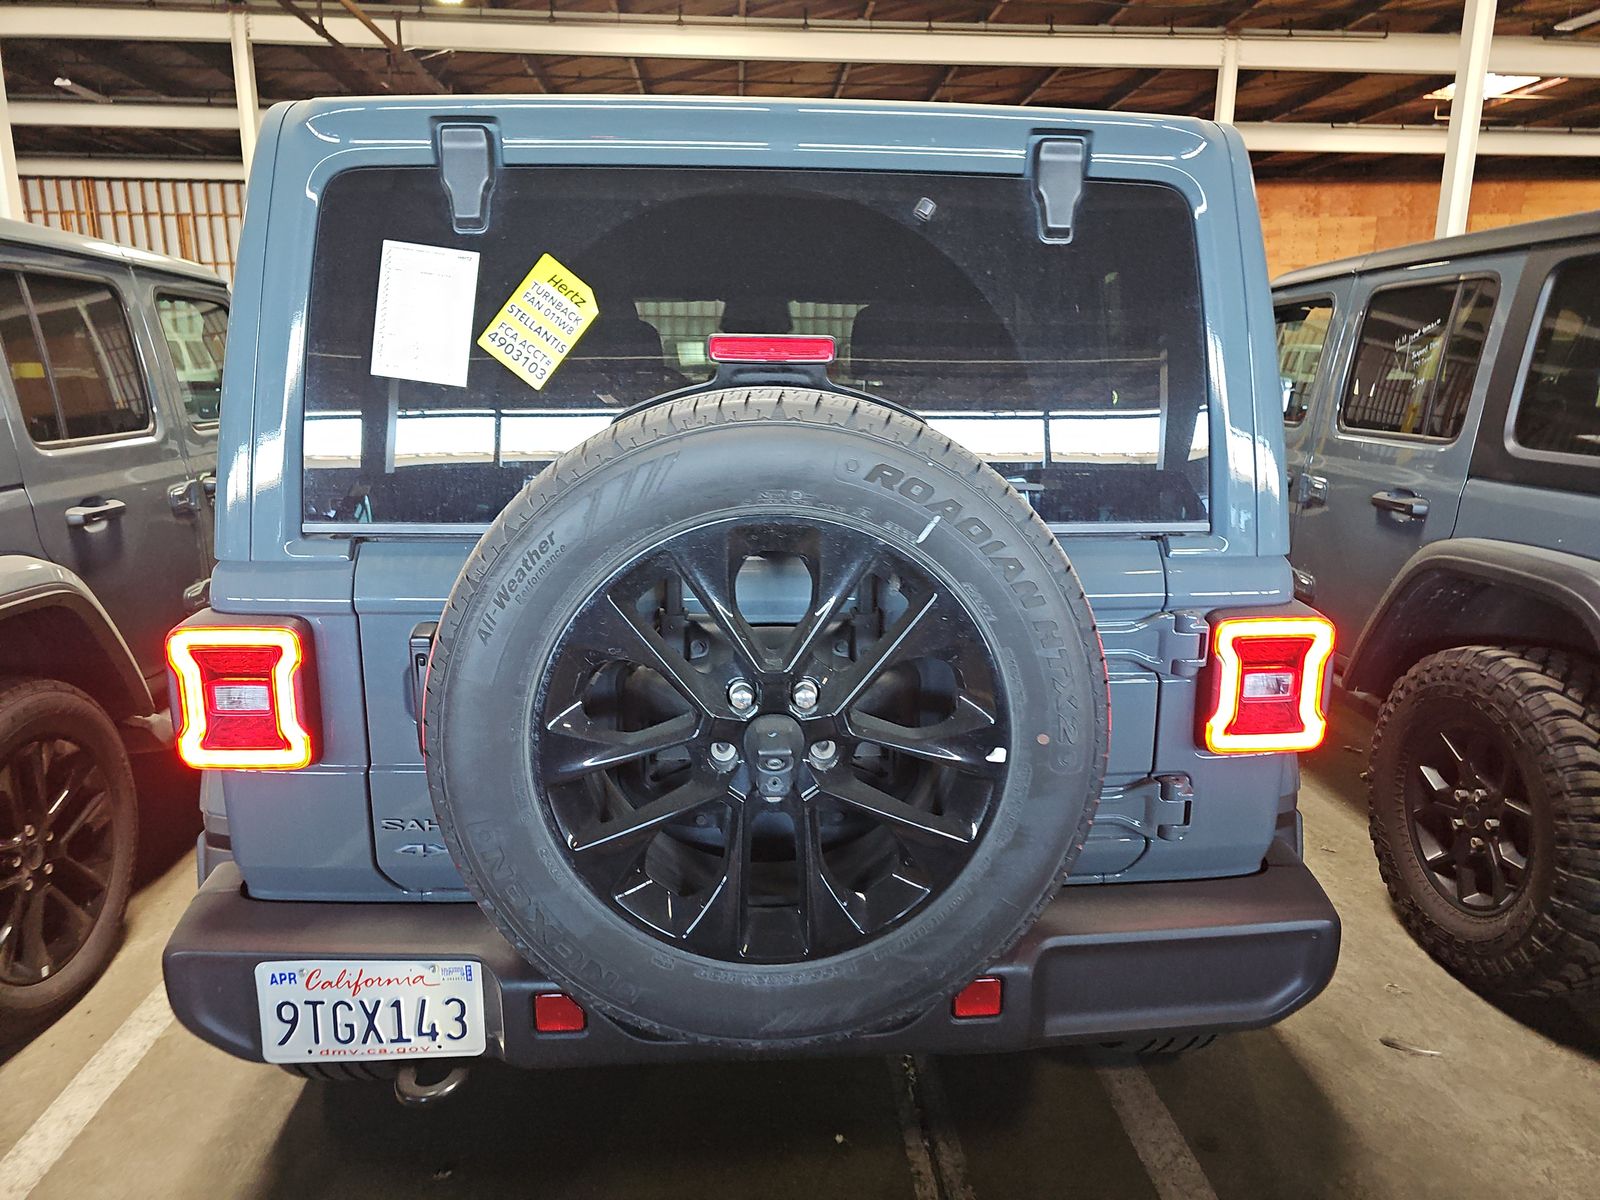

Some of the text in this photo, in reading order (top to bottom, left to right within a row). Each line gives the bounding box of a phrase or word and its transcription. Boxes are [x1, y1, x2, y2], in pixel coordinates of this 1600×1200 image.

[532, 281, 583, 324] TURNBACK
[547, 274, 586, 308] Hertz
[498, 322, 520, 342] FCA
[507, 304, 566, 353] STELLANTIS
[523, 292, 573, 335] FAN 011W8
[488, 332, 546, 380] 4903103
[863, 463, 1046, 610] ROADIAN
[477, 530, 557, 647] All-Weather
[513, 544, 567, 605] Performance
[269, 972, 298, 986] APR
[304, 967, 441, 997] California
[275, 997, 469, 1046] 9TGX143
[319, 1045, 431, 1057] dmv.ca.gov
